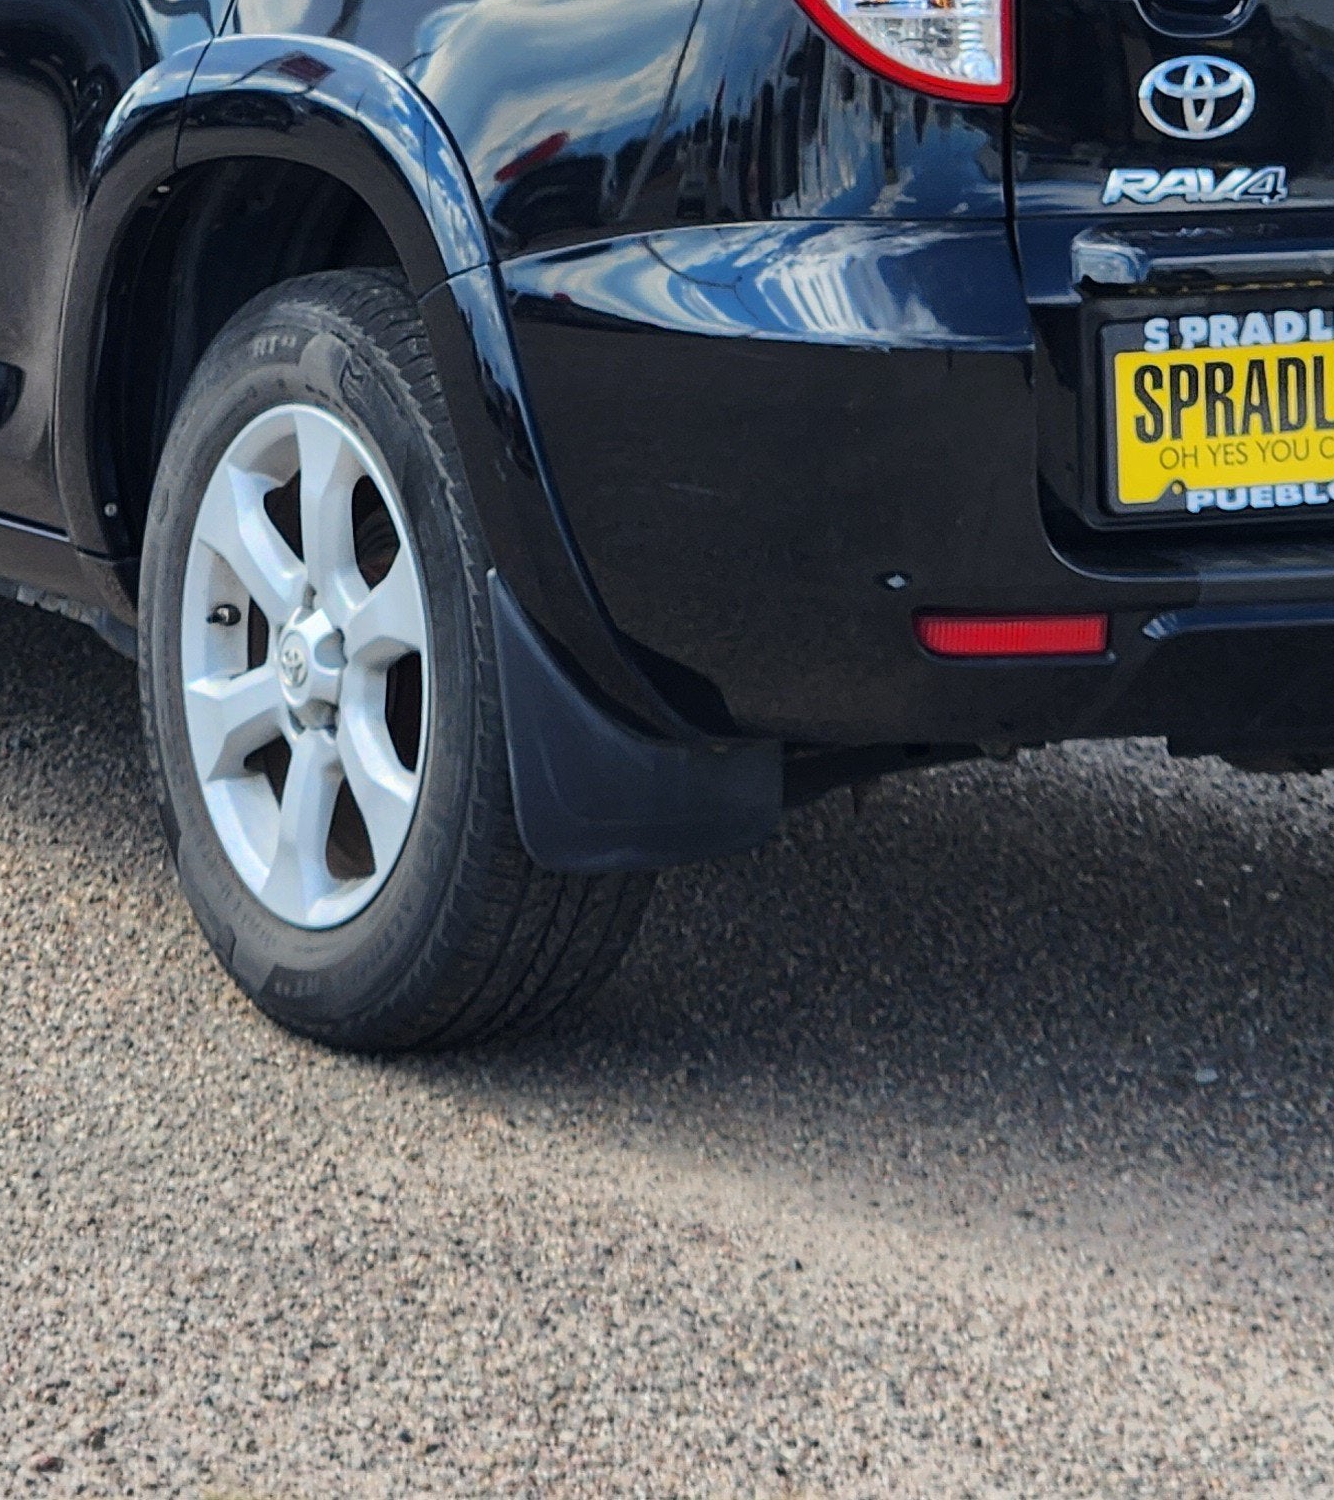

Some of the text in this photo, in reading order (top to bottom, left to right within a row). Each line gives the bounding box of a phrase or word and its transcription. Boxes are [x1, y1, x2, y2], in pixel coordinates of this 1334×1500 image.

[1102, 165, 1289, 205] RAV4
[1159, 445, 1199, 471] OH
[1207, 441, 1249, 467] YES
[1256, 438, 1311, 463] YOU
